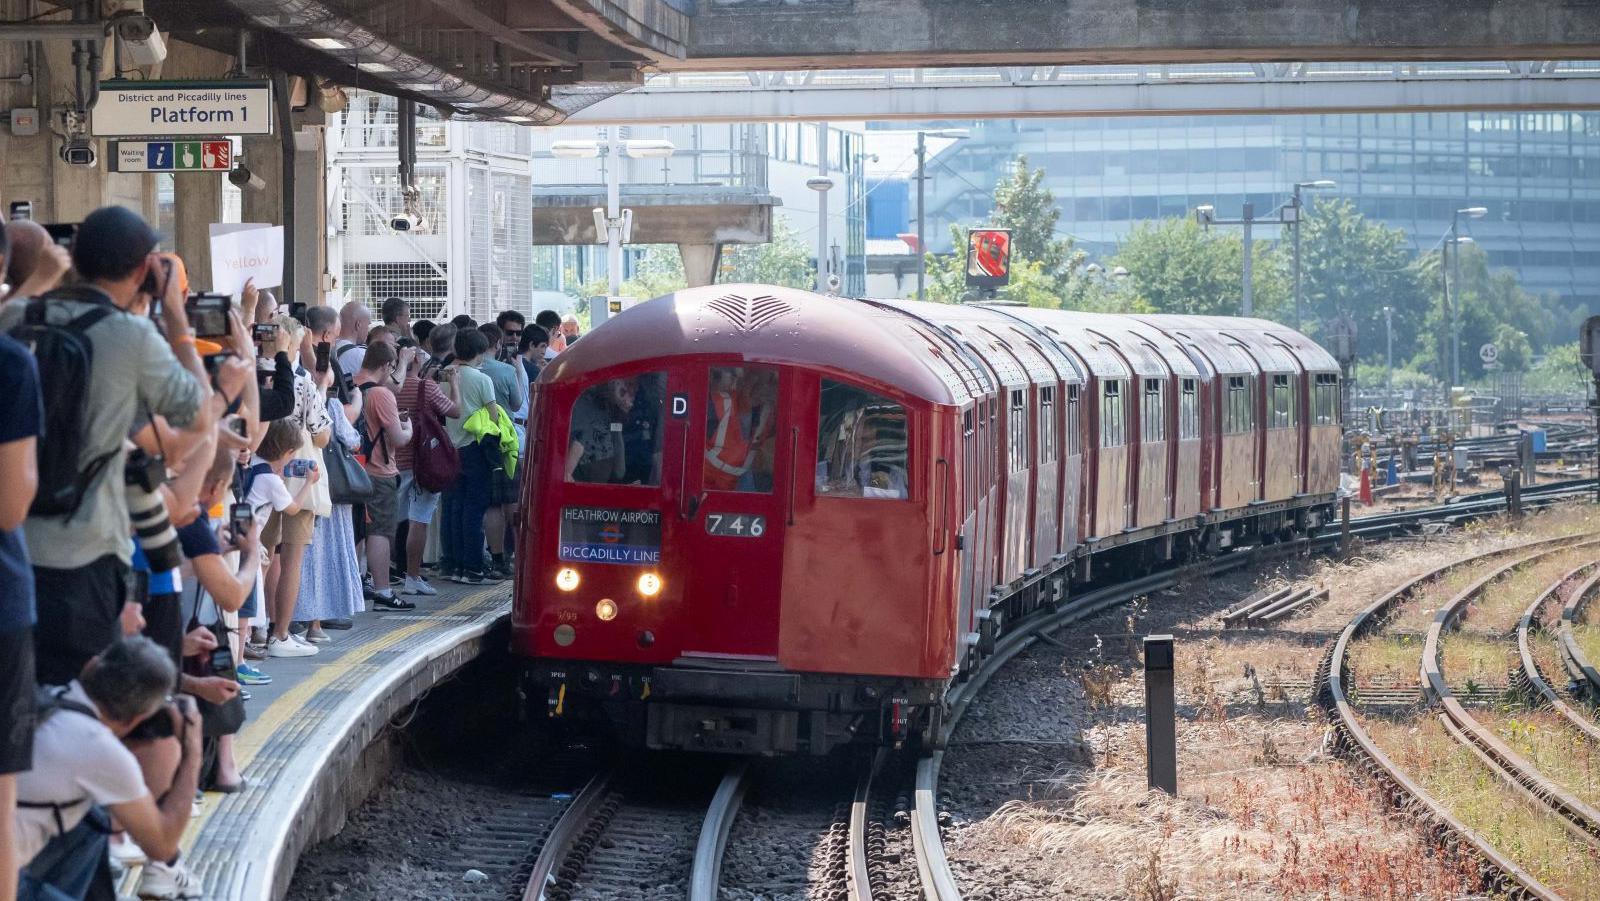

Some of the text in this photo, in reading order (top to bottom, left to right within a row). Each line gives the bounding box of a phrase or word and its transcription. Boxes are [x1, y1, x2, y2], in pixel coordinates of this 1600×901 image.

[118, 93, 247, 102] District and Piccadilly lines
[151, 106, 247, 122] Platform 1
[1482, 348, 1495, 357] 45
[673, 397, 687, 414] D
[565, 508, 660, 524] HEATHROW AIRPORT
[708, 514, 763, 536] 746
[562, 546, 660, 562] PICCADILLY LINE
